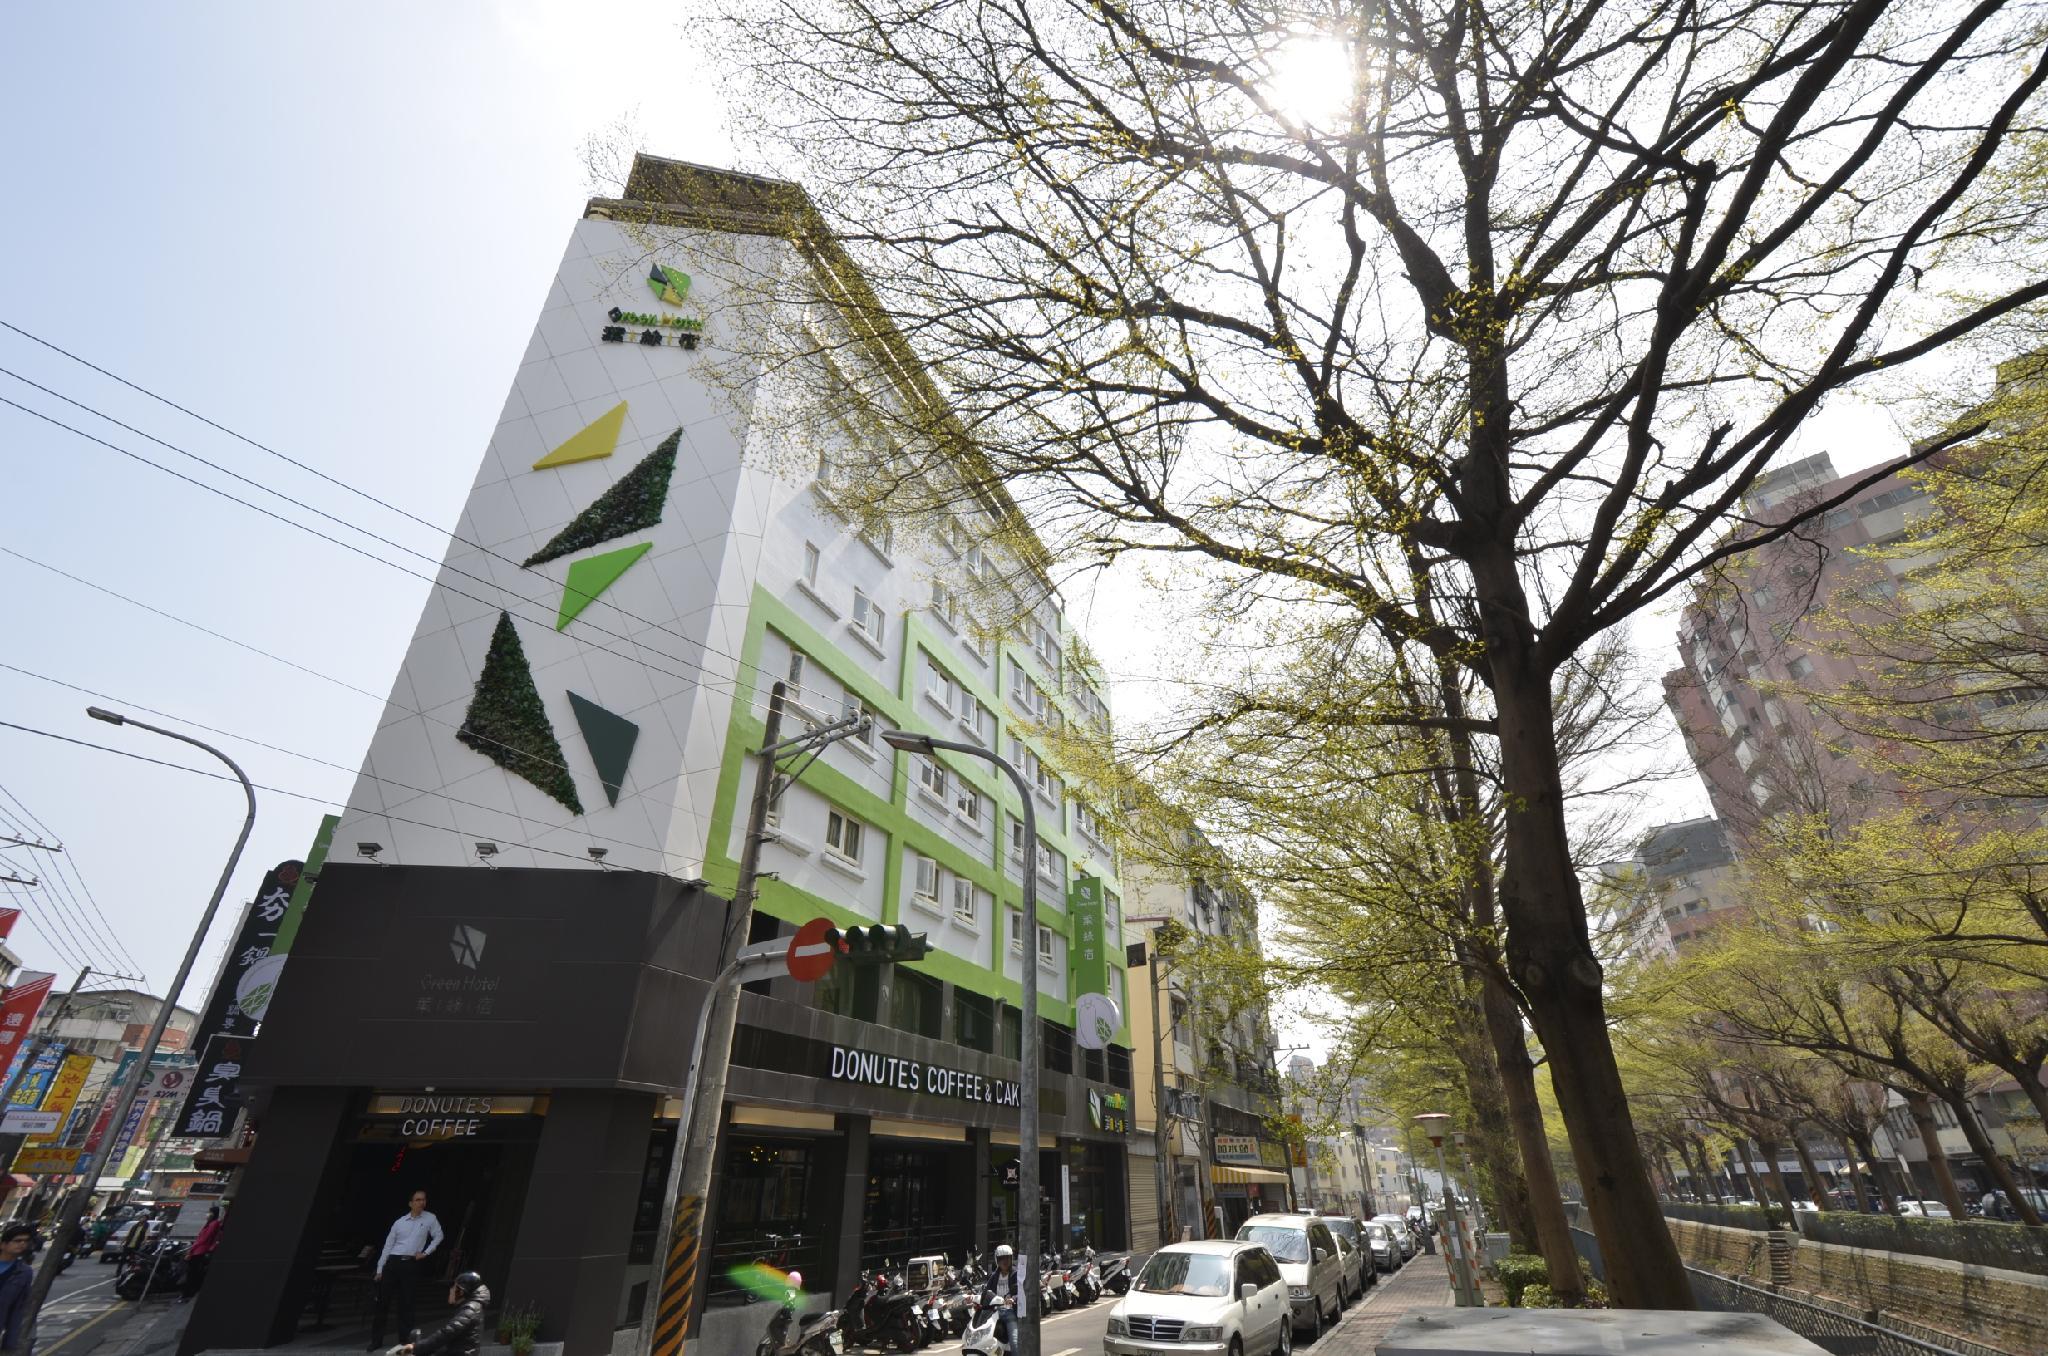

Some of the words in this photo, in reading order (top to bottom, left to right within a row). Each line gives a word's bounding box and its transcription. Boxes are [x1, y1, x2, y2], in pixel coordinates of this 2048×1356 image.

[831, 1046, 920, 1090] DONUTES
[927, 1066, 982, 1101] COFFEE
[984, 1083, 993, 1103] &
[996, 1080, 1021, 1108] CAK
[400, 1096, 492, 1114] DONUTES
[401, 1119, 480, 1136] COFFEE
